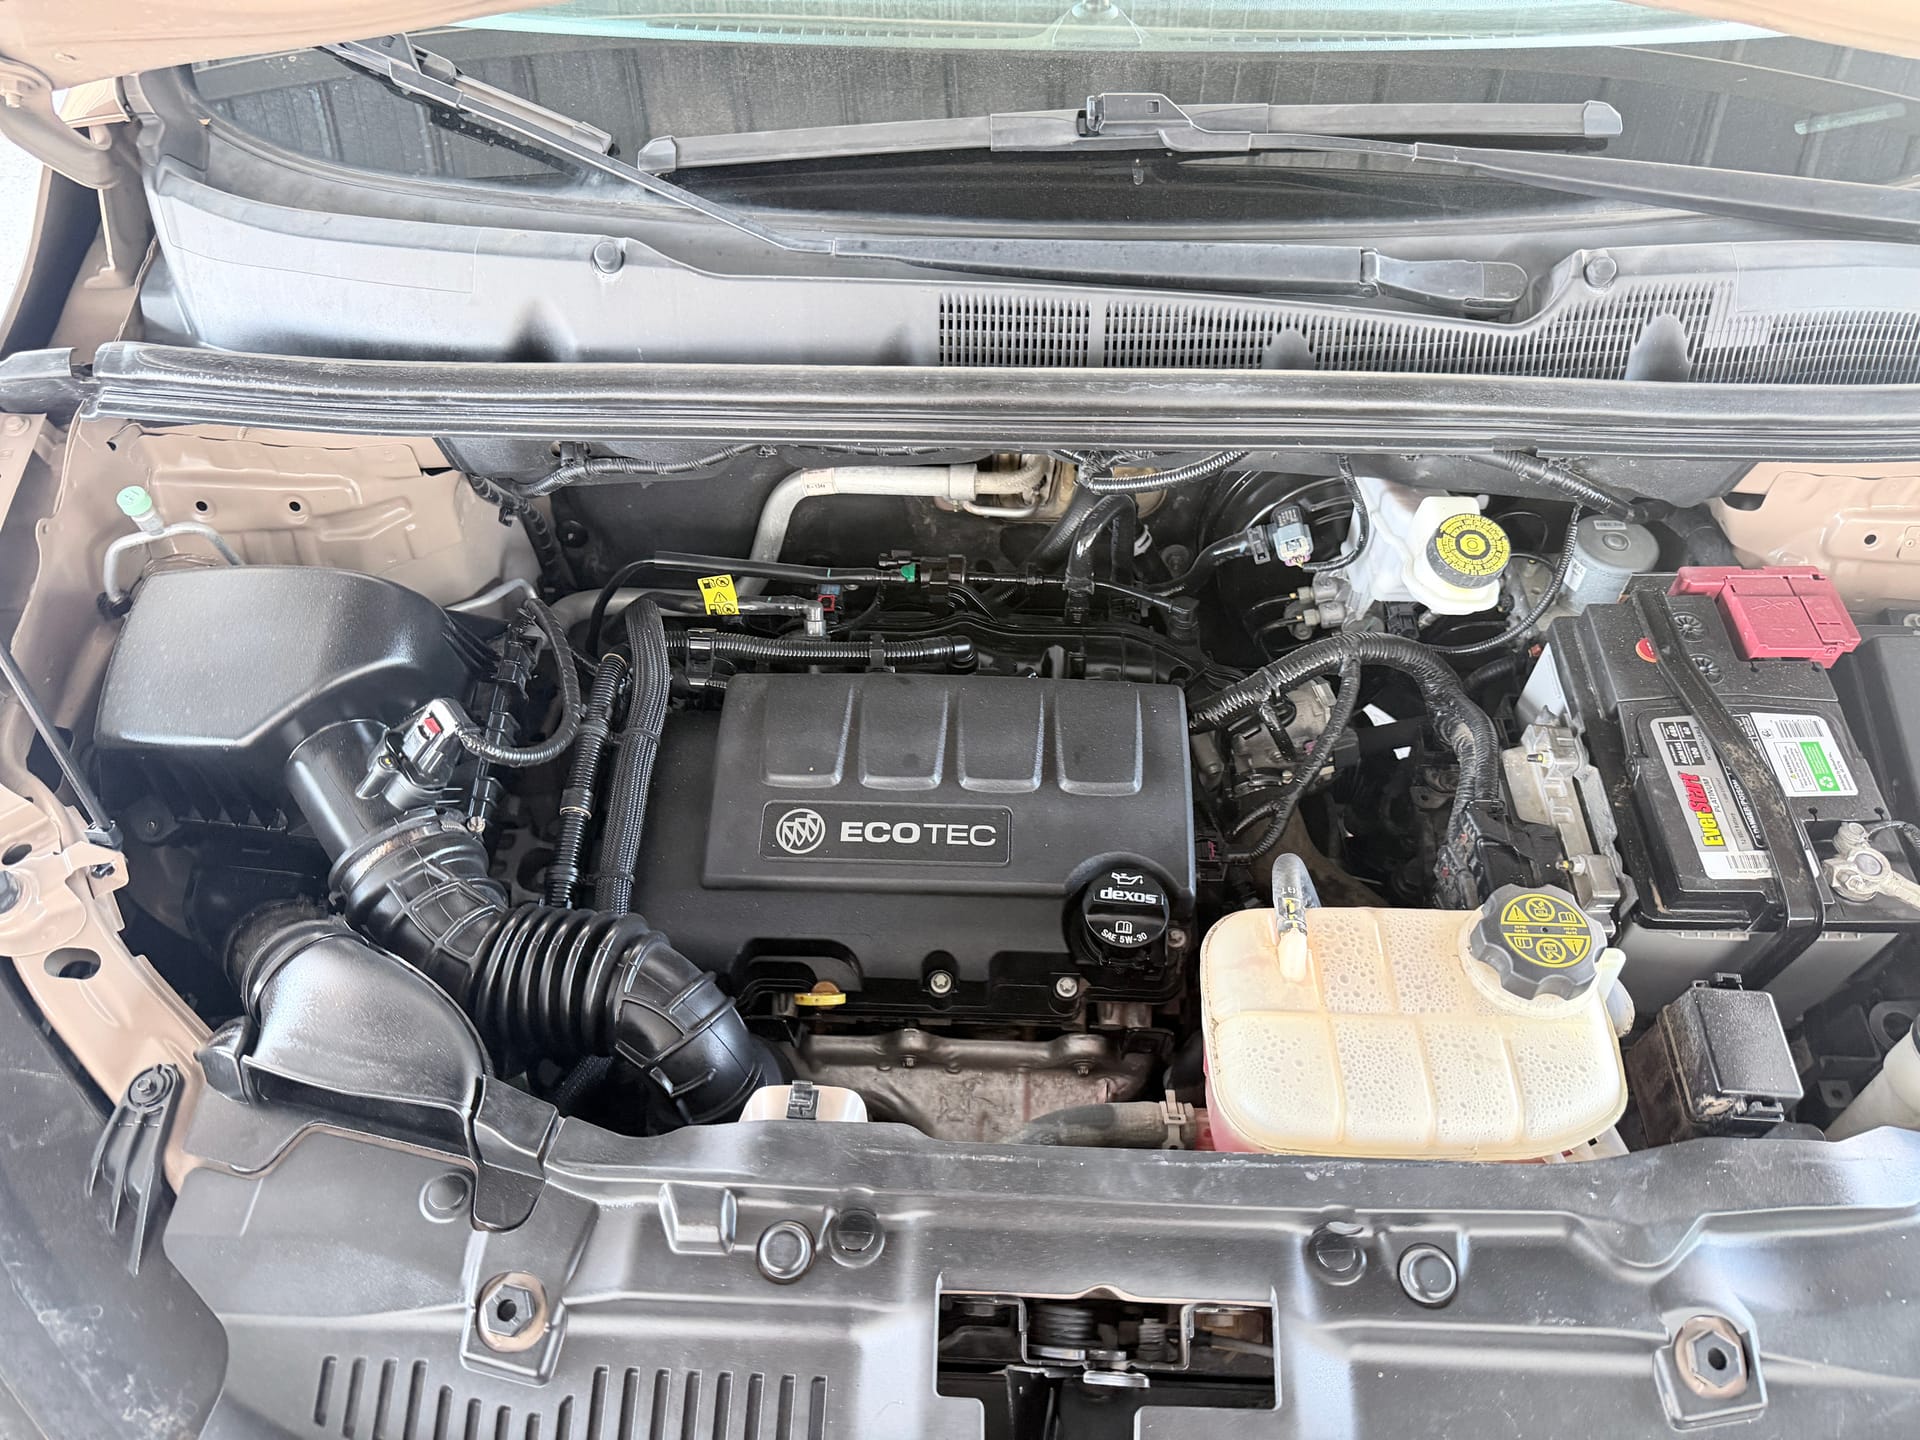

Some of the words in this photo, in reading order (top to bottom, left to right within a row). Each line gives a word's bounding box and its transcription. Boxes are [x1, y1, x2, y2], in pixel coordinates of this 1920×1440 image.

[1702, 778, 1721, 813] PLATINUM
[1678, 772, 1725, 846] EverStart
[840, 821, 997, 847] ECOTEC
[1099, 886, 1158, 905] dexos
[1100, 928, 1117, 942] SAE
[1119, 931, 1148, 945] 5W-30
